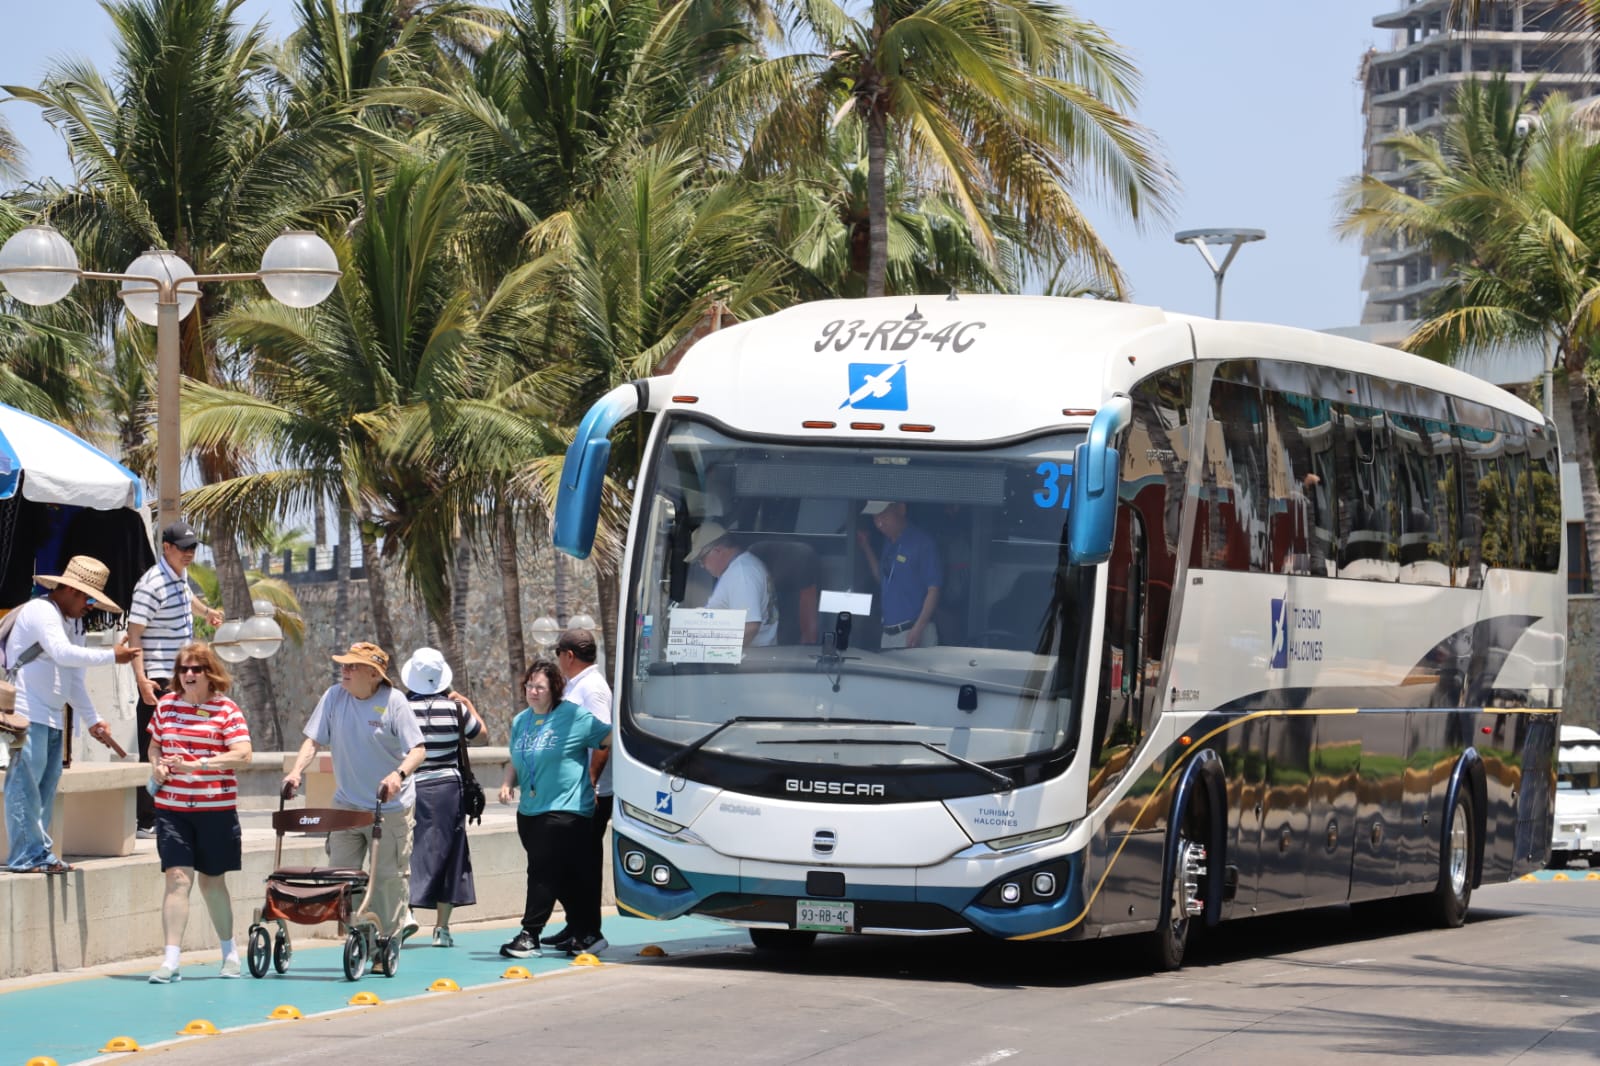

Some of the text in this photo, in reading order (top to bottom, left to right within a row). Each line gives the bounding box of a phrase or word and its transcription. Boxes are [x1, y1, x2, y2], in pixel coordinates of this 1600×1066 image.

[814, 319, 987, 353] 93-RB-4C
[1293, 608, 1321, 630] TURISMO
[1289, 640, 1323, 661] HALCONES
[785, 778, 885, 797] BUSSCAR
[974, 817, 1018, 827] HALCONES
[979, 808, 1015, 818] TURISMO
[801, 908, 849, 923] 93-RB-4C
